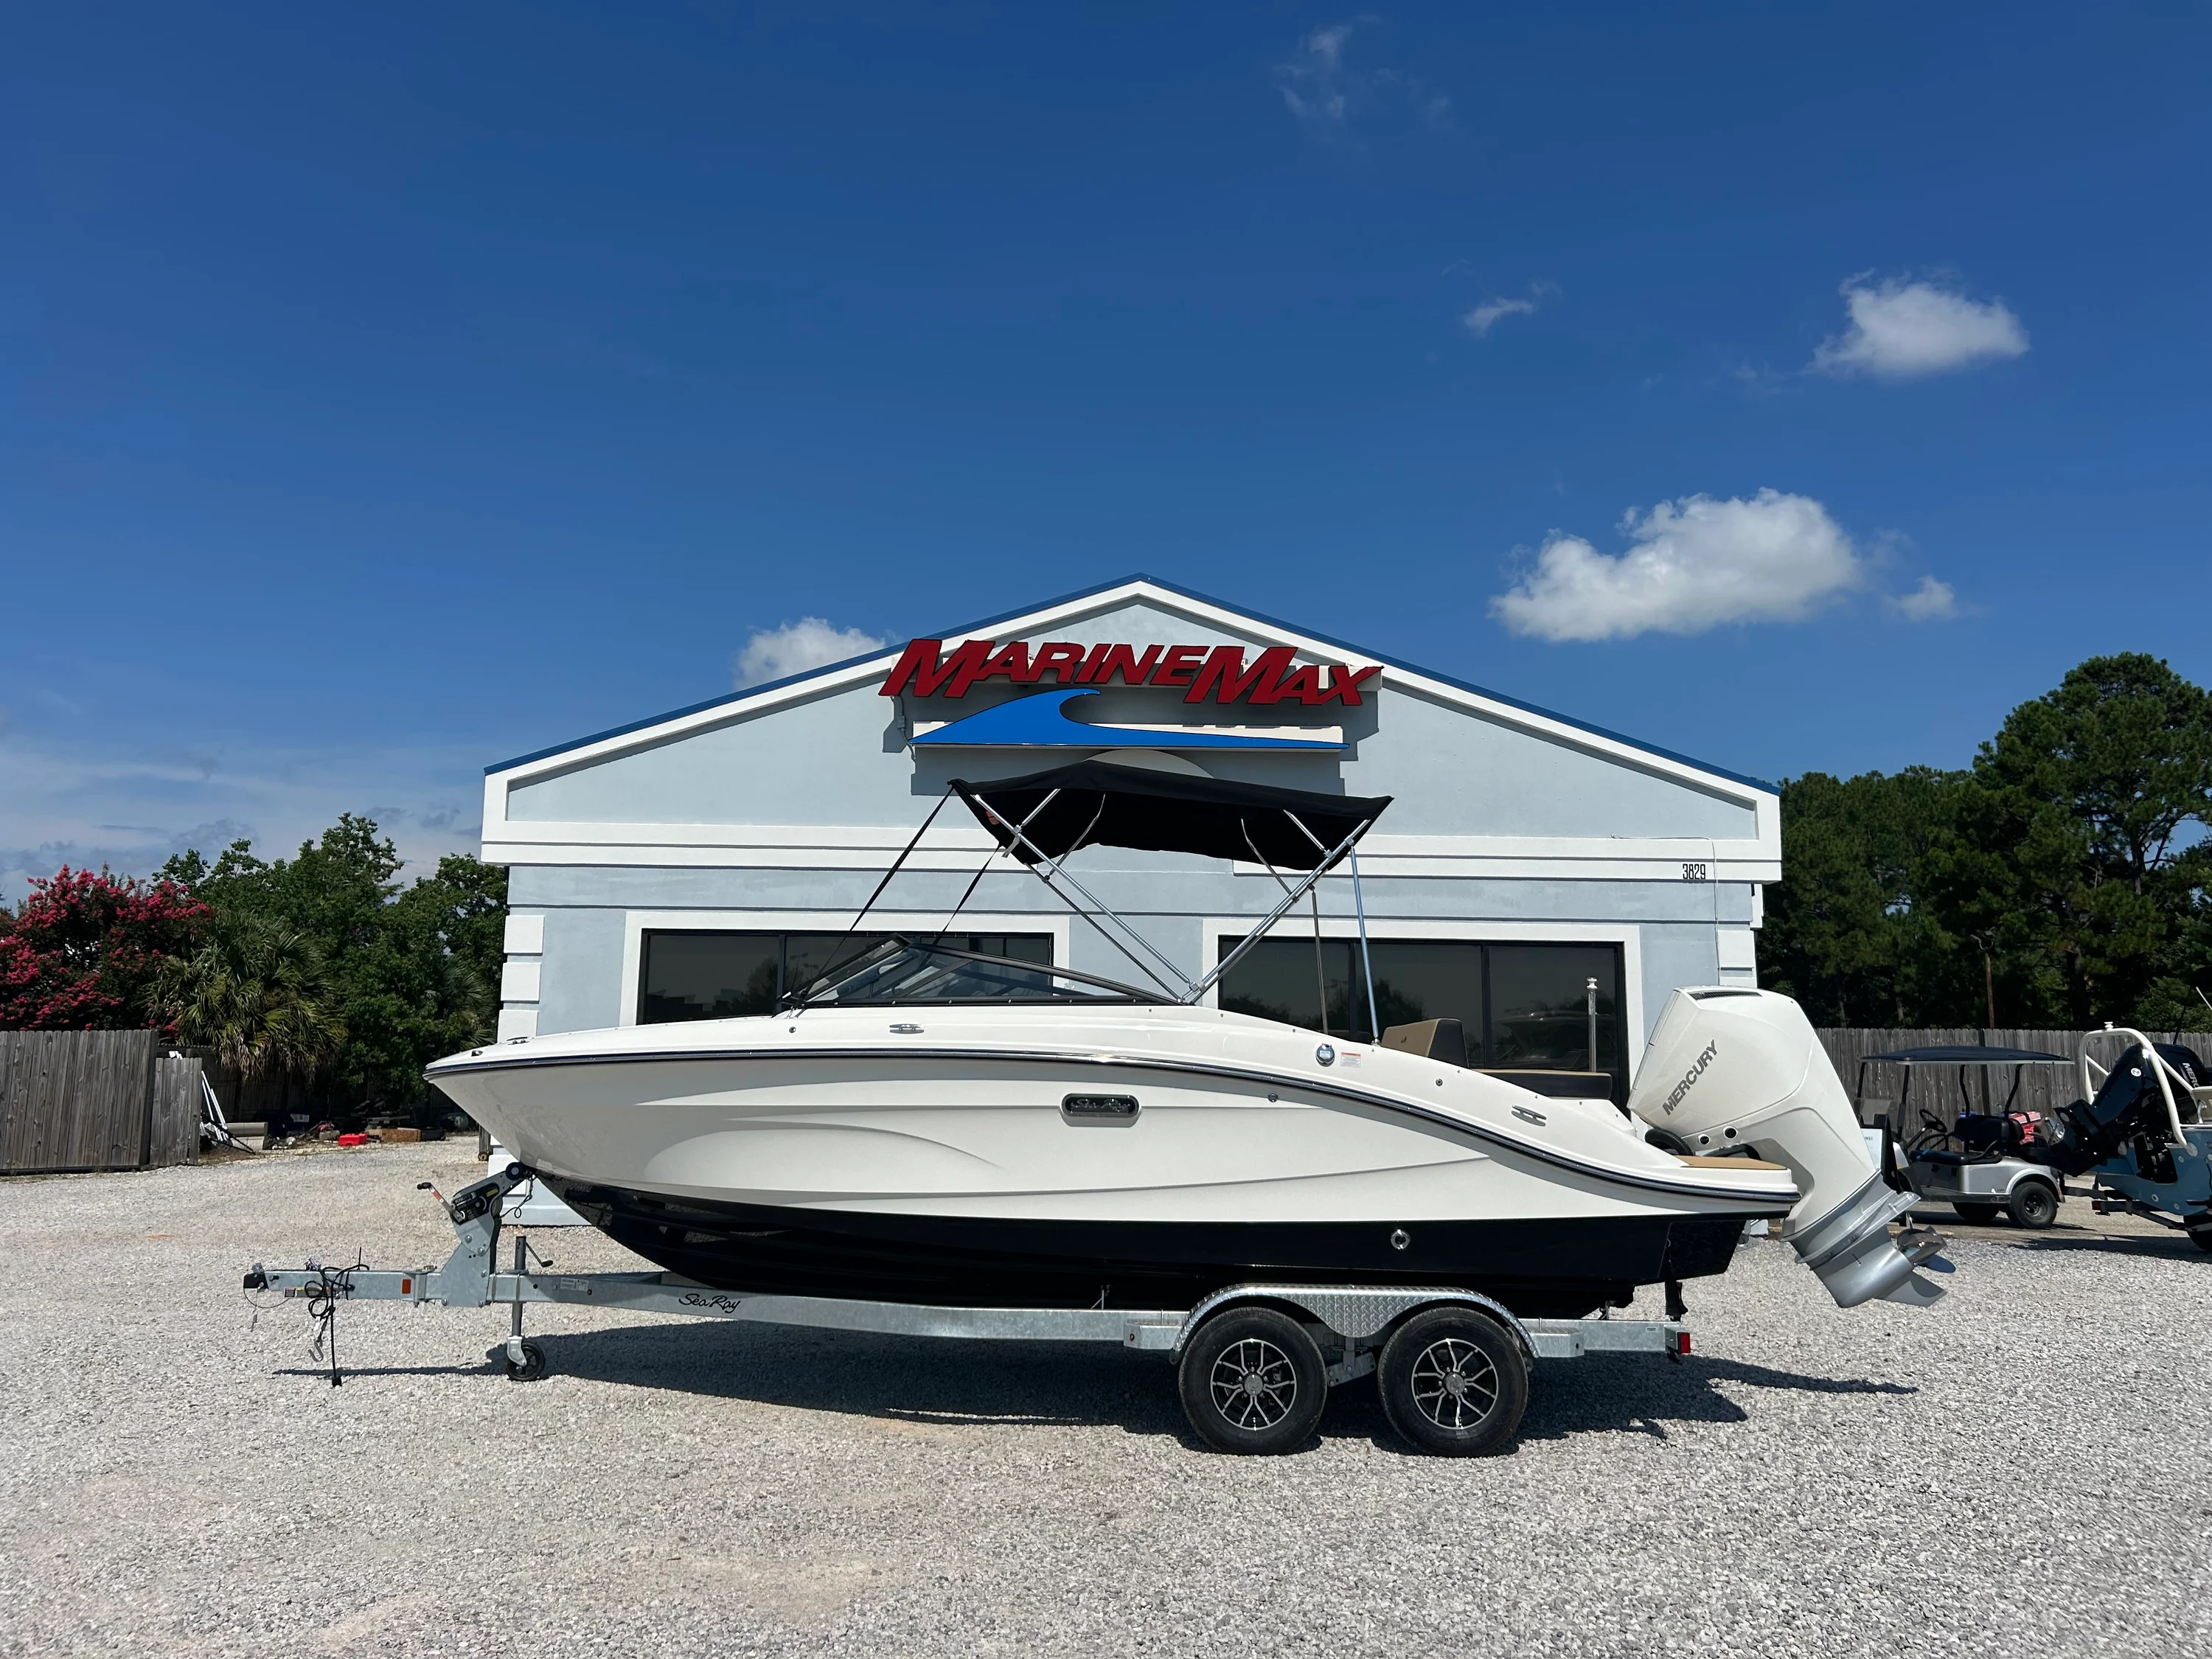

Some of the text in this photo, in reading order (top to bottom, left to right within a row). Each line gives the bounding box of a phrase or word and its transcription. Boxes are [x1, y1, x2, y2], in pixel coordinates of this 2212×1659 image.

[1682, 863, 1706, 880] 3829
[1661, 1038, 1717, 1116] MERCURY
[678, 1293, 741, 1314] Sea Ray
